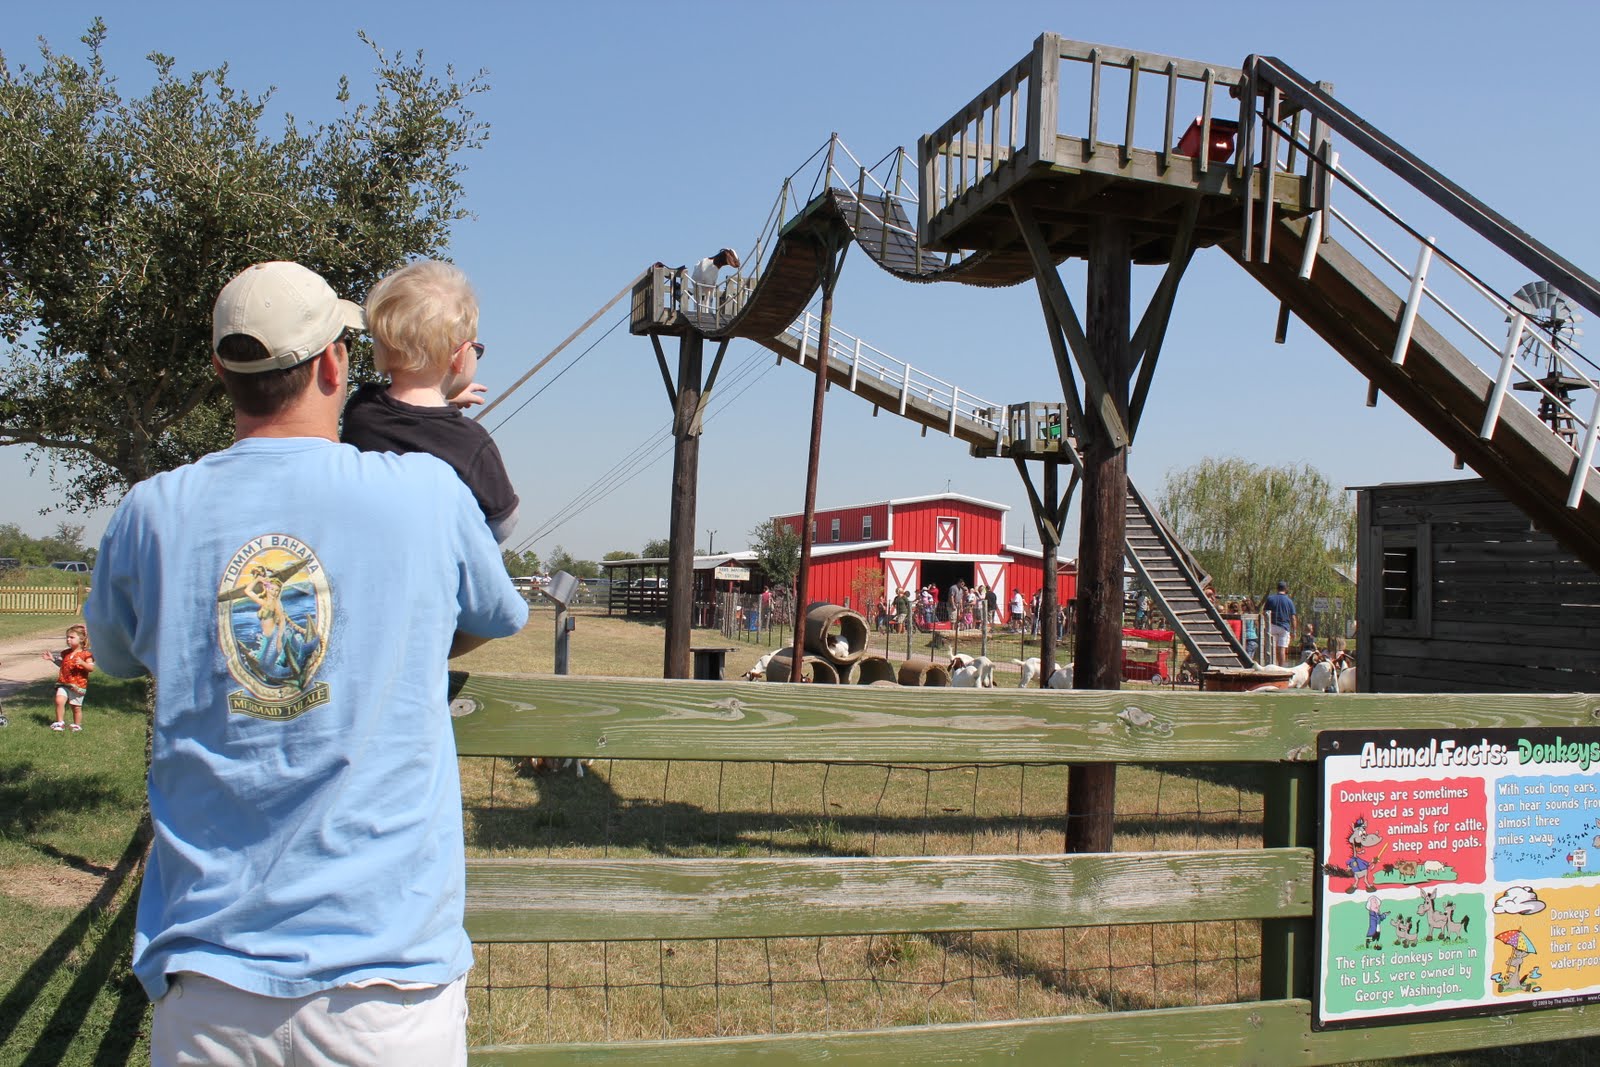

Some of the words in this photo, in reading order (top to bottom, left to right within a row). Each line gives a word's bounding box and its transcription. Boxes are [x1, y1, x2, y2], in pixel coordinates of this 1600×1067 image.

[223, 539, 264, 584] TOMMY
[271, 536, 320, 575] BAHAMA
[233, 700, 282, 716] MERMAID
[305, 689, 326, 704] ALE
[1360, 738, 1436, 769] Animal
[1441, 738, 1508, 766] Facts:
[1517, 736, 1600, 770] Donkeys
[1340, 790, 1385, 805] Donkeys
[1391, 790, 1408, 800] are
[1413, 787, 1468, 800] sometimes
[1499, 783, 1519, 795] With
[1524, 782, 1544, 794] such
[1549, 781, 1570, 796] long
[1372, 805, 1397, 818] used
[1402, 807, 1414, 817] as
[1419, 804, 1449, 819] guard
[1498, 802, 1515, 812] can
[1519, 799, 1539, 811] hear
[1545, 799, 1578, 810] sounds
[1387, 821, 1428, 835] animals
[1434, 821, 1449, 832] for
[1454, 818, 1485, 832] cattle,
[1498, 817, 1530, 828] almost
[1535, 816, 1560, 827] three
[1393, 838, 1423, 852] sheep
[1428, 836, 1447, 849] and
[1452, 836, 1482, 852] goats.
[1498, 833, 1523, 845] miles
[1550, 908, 1590, 923] Donkeys
[1550, 925, 1566, 937] like
[1571, 925, 1590, 935] rain
[1550, 940, 1572, 952] their
[1577, 937, 1596, 950] coat
[1336, 957, 1355, 970] The
[1361, 954, 1385, 968] first
[1390, 950, 1433, 966] donkeys
[1438, 947, 1462, 960] born
[1467, 947, 1477, 958] in
[1340, 973, 1357, 986] the
[1363, 971, 1383, 984] U.S.
[1390, 971, 1416, 982] were
[1421, 967, 1454, 979] owned
[1459, 964, 1472, 980] by
[1355, 988, 1394, 1003] George
[1400, 983, 1462, 999] Washington.
